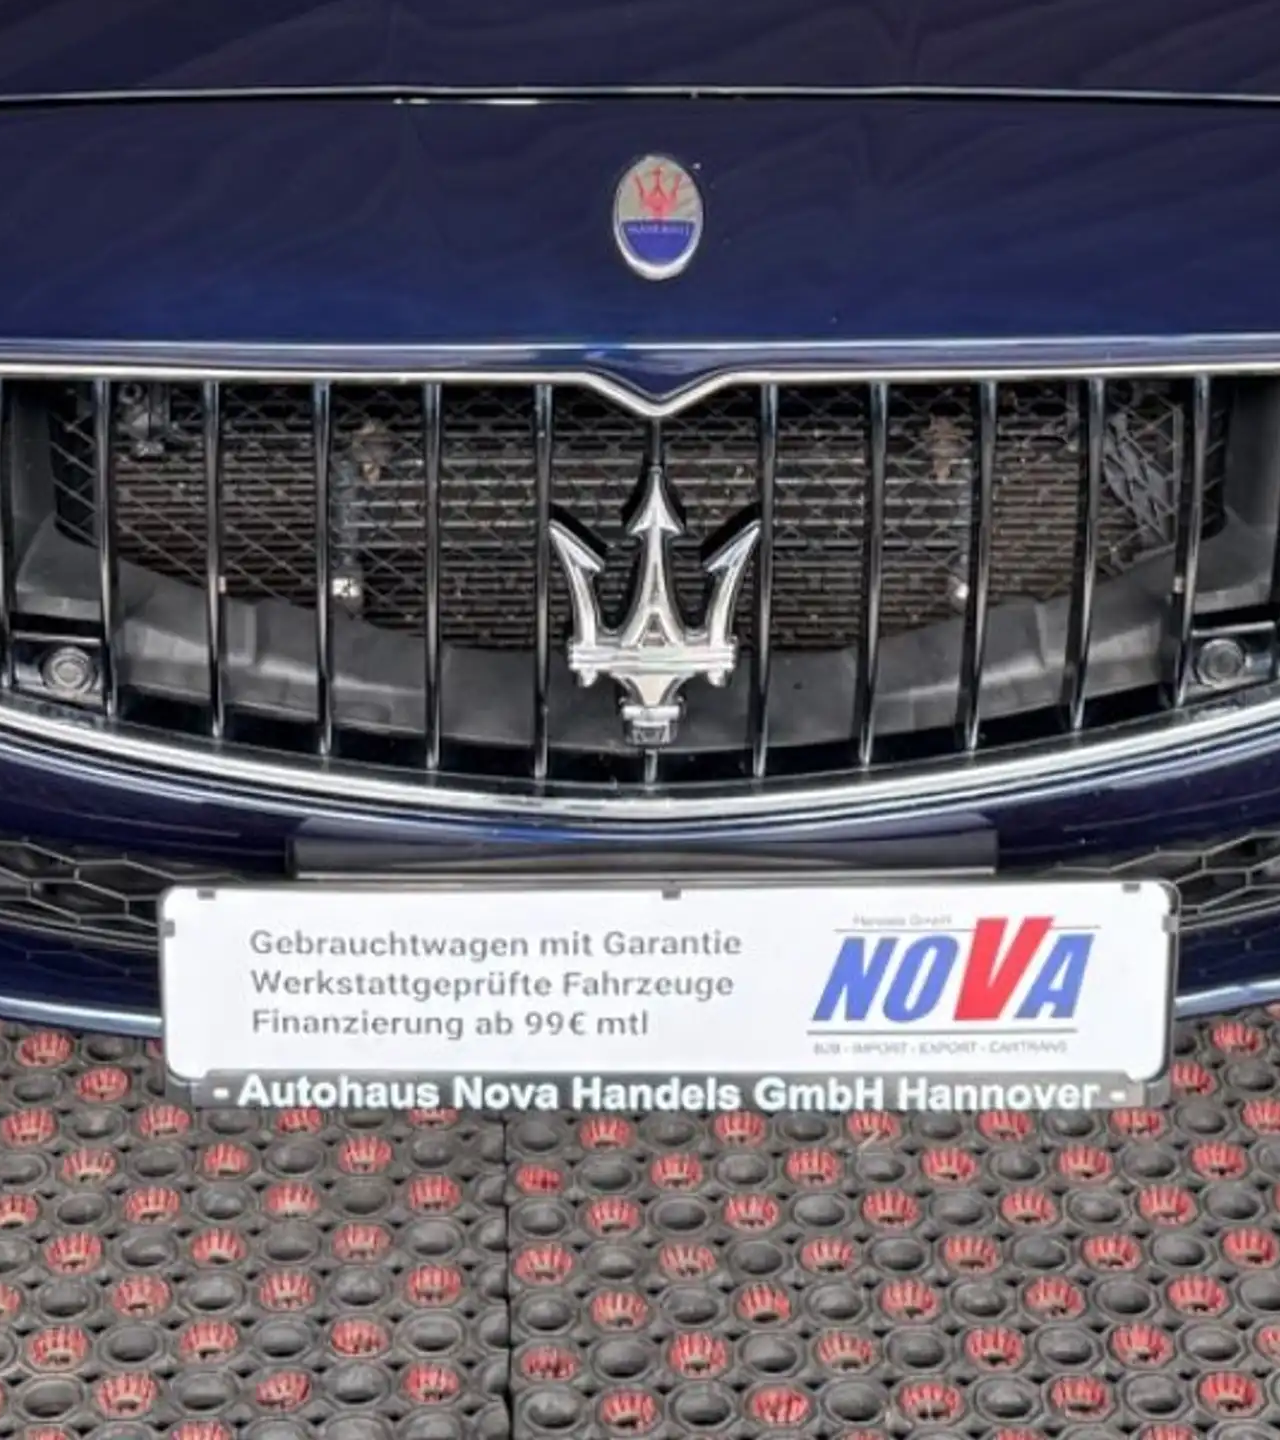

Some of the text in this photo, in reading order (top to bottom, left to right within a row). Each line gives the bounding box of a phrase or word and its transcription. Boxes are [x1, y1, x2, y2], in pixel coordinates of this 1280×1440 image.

[249, 929, 742, 962] Gebrauchtwagen mit Garantie
[250, 969, 735, 1003] Werkstattgeprüfte Fahrzeuge
[811, 916, 1096, 1024] NOVA
[252, 1008, 650, 1040] Finanzierung ab 99€ mtl
[236, 1073, 441, 1108] Autohaus
[452, 1075, 560, 1110] Nova
[572, 1075, 741, 1111] Handels
[753, 1075, 884, 1111] GmbH
[896, 1076, 1102, 1111] Hannover
